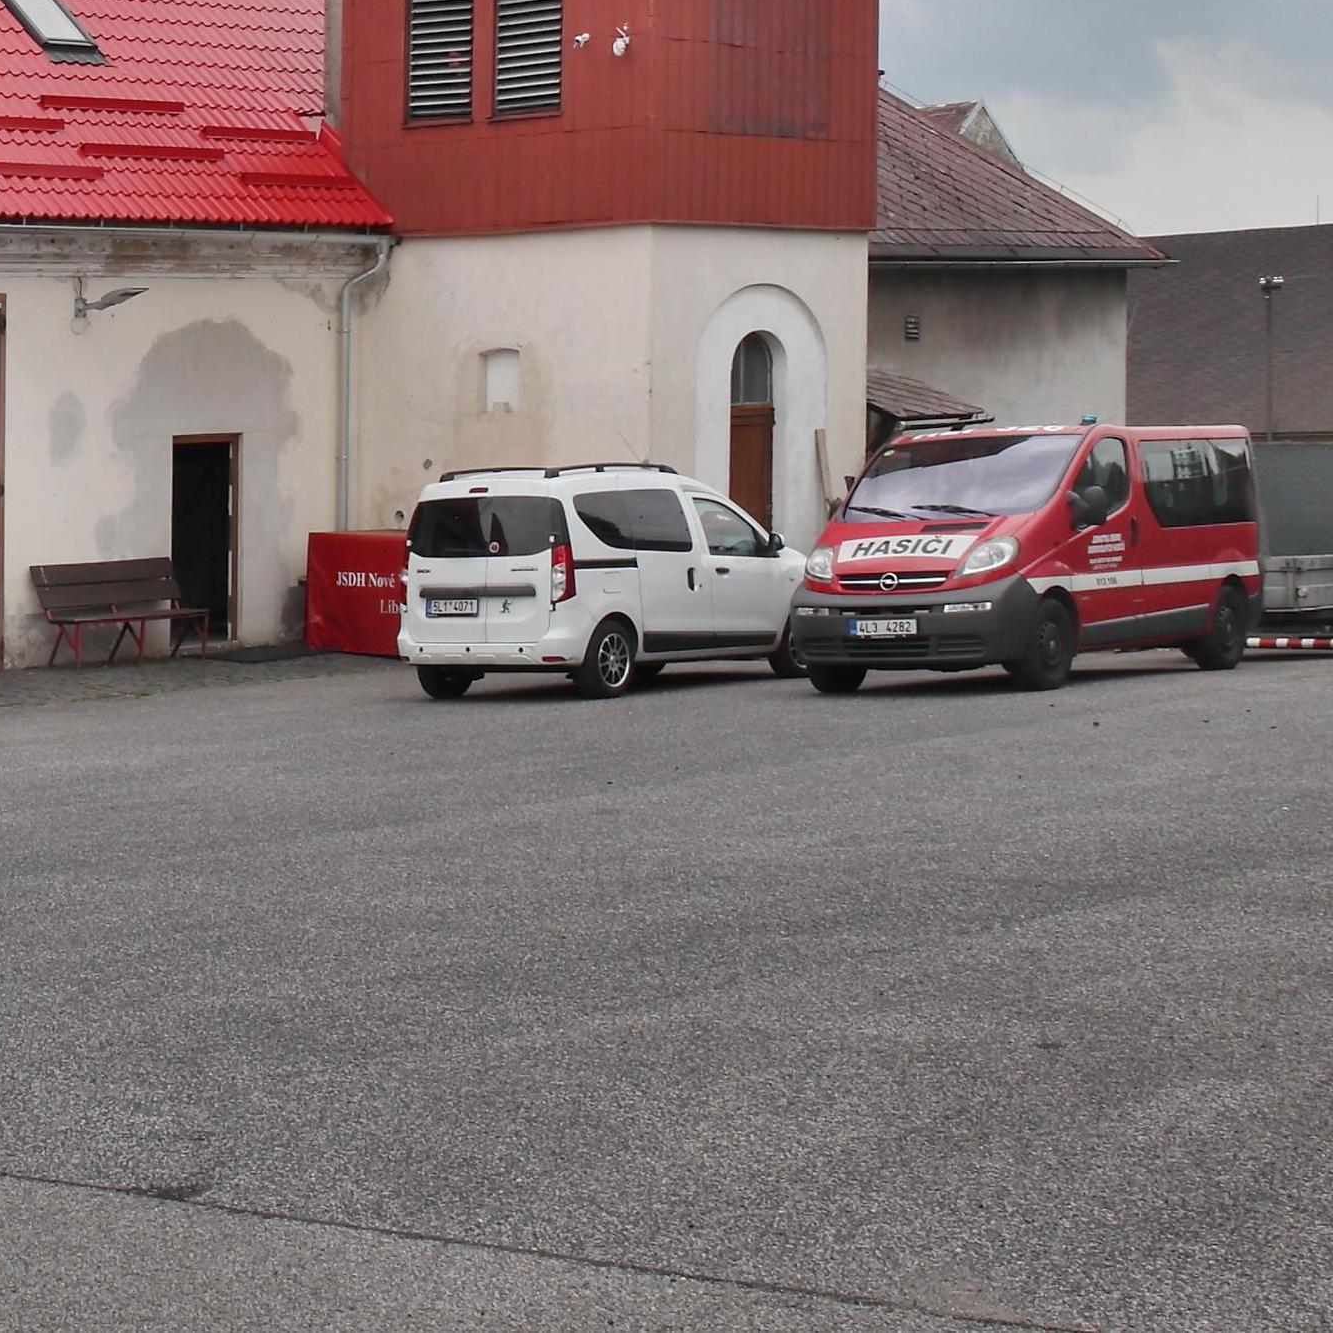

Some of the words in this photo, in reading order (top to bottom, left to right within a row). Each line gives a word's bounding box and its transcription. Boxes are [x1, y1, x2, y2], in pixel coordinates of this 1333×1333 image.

[851, 535, 954, 559] HASIČI
[336, 571, 366, 587] JSDH
[368, 572, 396, 588] Nové
[380, 599, 400, 614] Lib
[859, 620, 878, 633] 4L3
[886, 620, 911, 633] 4282
